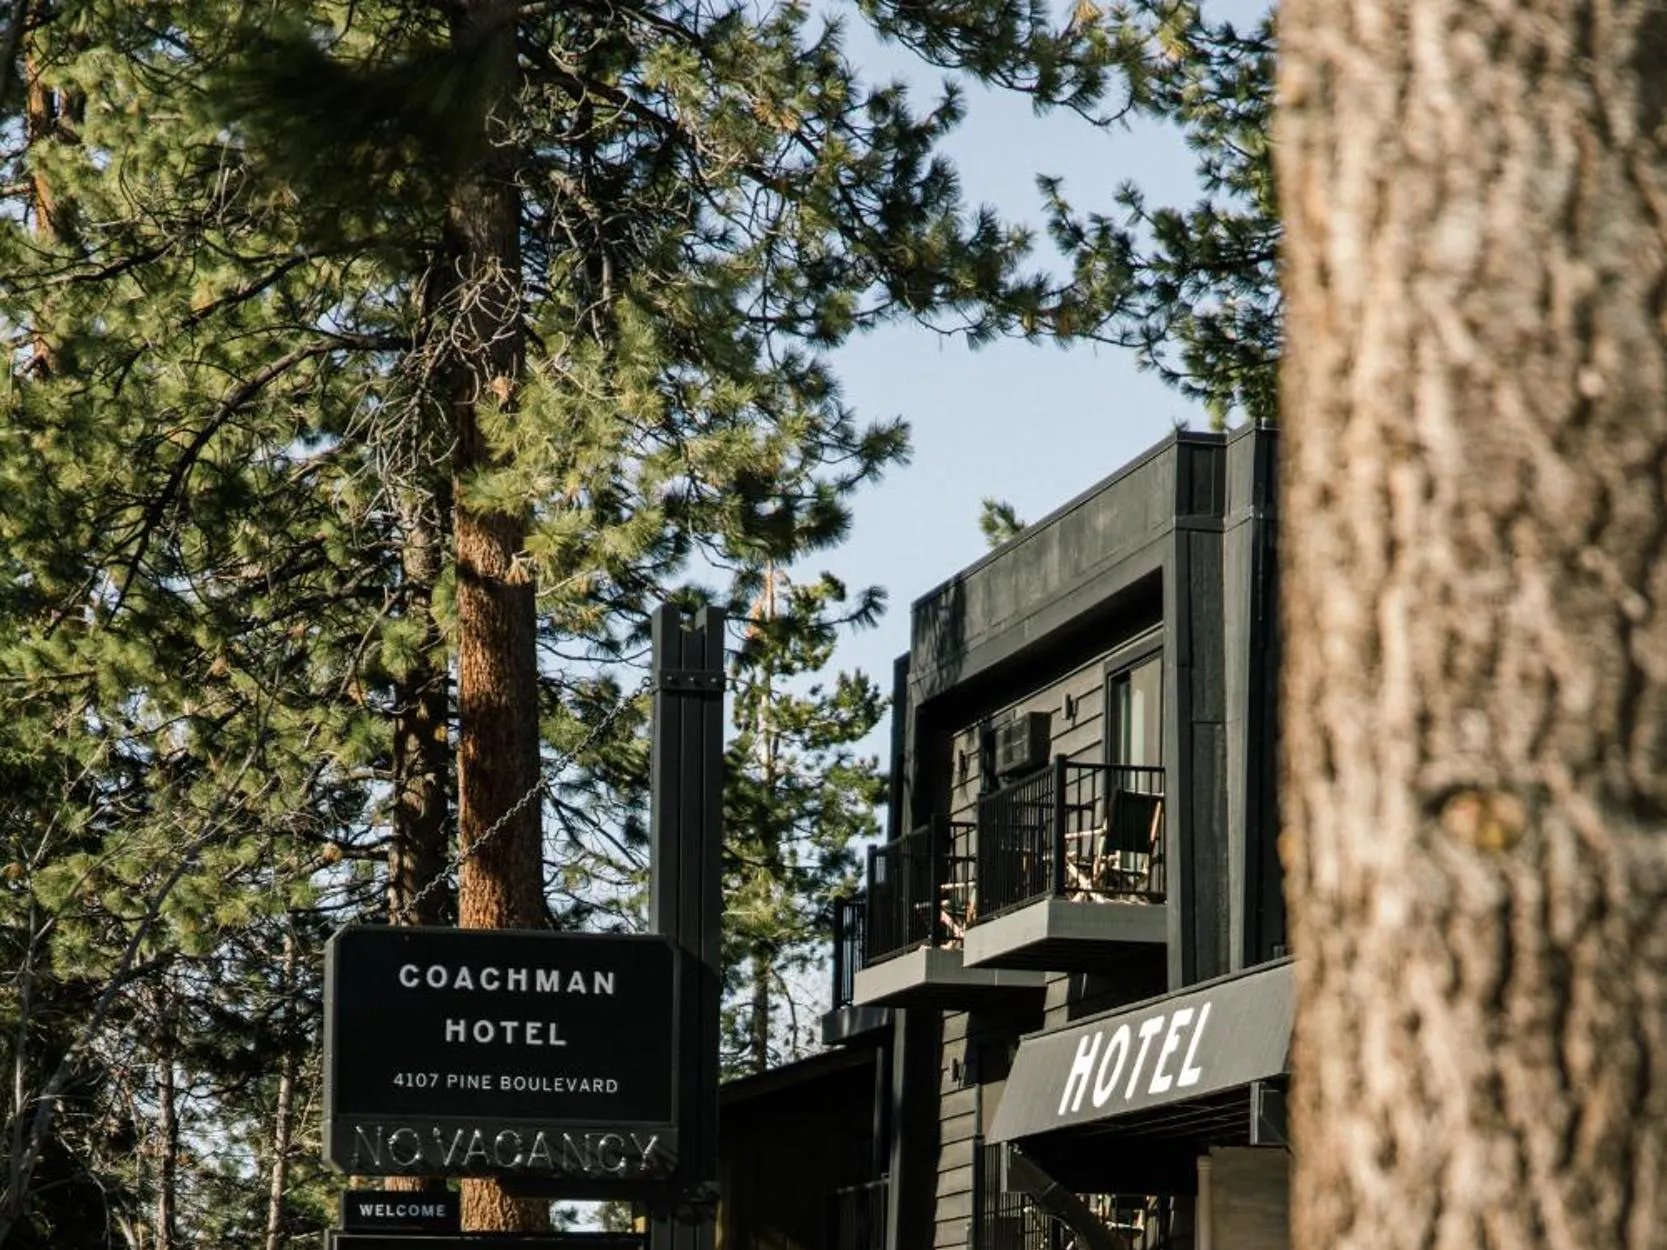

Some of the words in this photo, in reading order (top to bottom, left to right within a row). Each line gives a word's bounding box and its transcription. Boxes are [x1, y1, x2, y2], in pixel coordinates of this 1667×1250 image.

[399, 963, 615, 995] COACHMAN
[445, 1018, 567, 1046] HOTEL
[1058, 1002, 1211, 1115] HOTEL
[393, 1072, 439, 1088] 4107
[447, 1074, 492, 1090] PINE
[500, 1075, 619, 1094] BOULEVARD
[354, 1125, 421, 1167] NO
[432, 1127, 658, 1172] VACANCY
[359, 1203, 445, 1217] WELCOME
